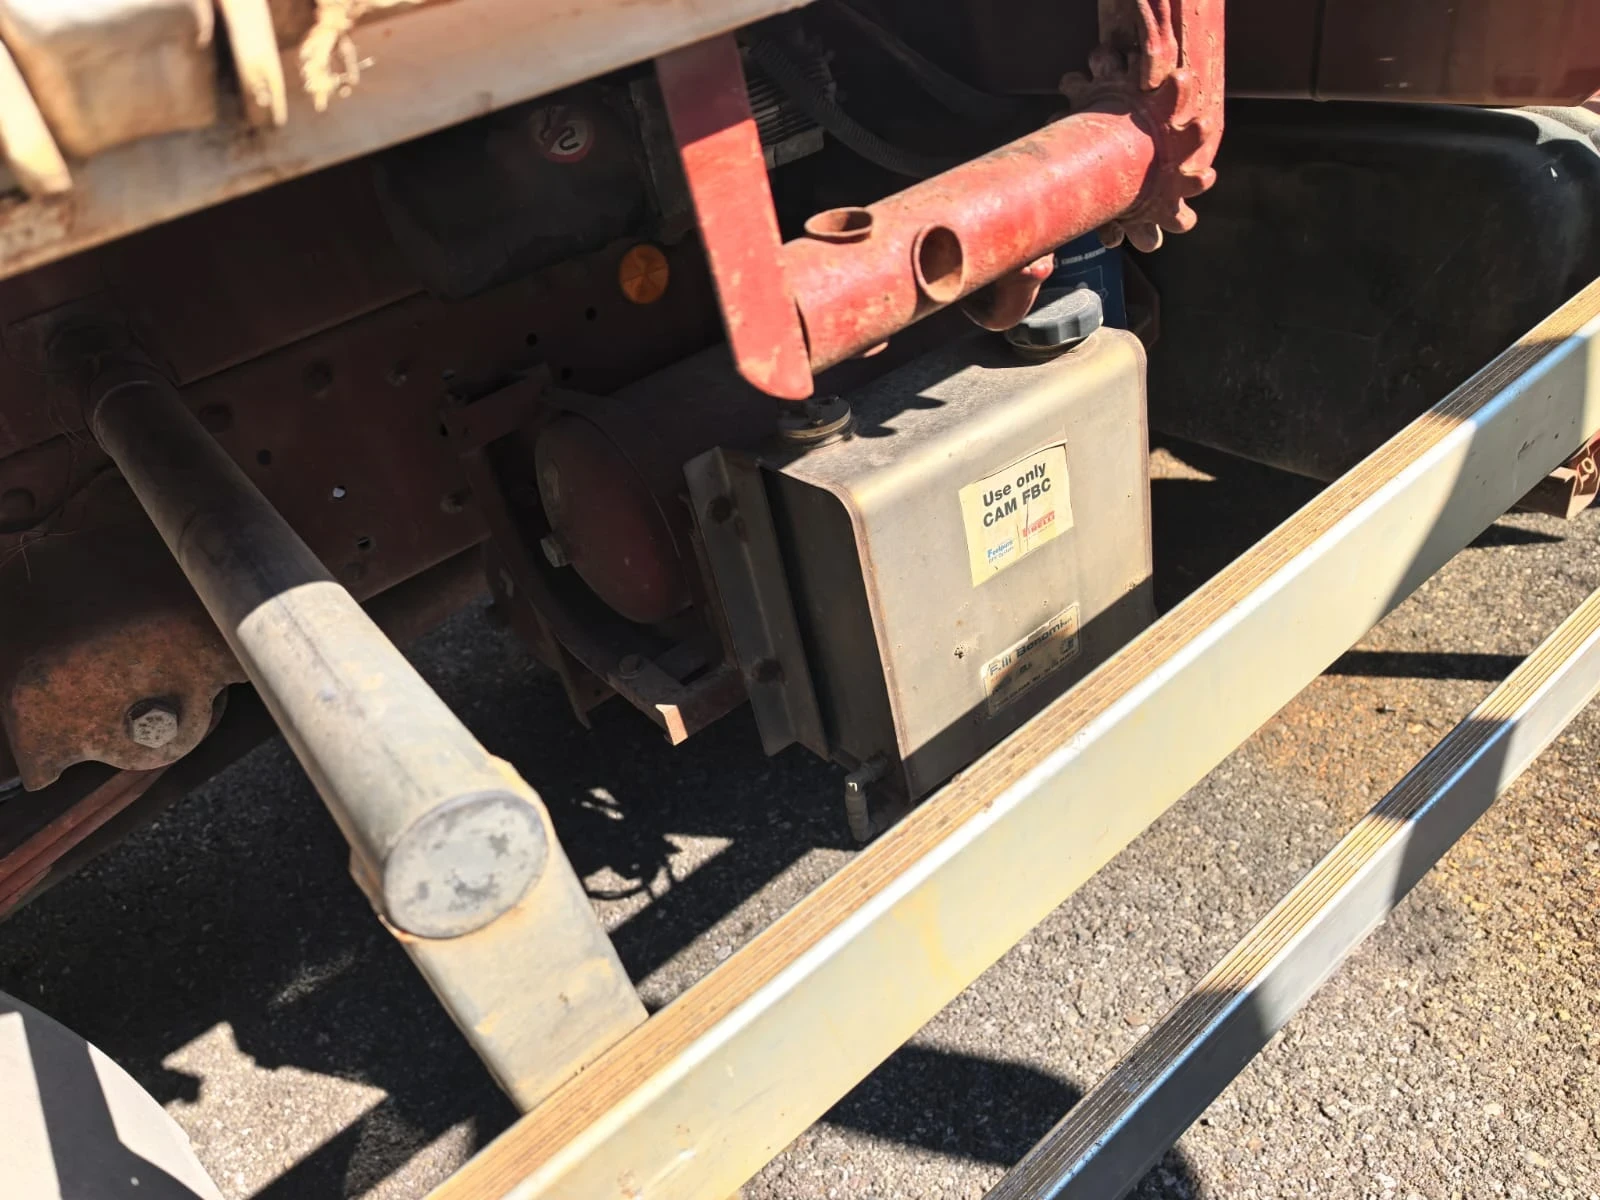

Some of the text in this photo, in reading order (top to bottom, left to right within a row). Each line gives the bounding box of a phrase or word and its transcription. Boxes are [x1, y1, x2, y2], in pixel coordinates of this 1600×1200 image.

[983, 463, 1046, 507] Use only
[983, 478, 1051, 527] CAM FBC
